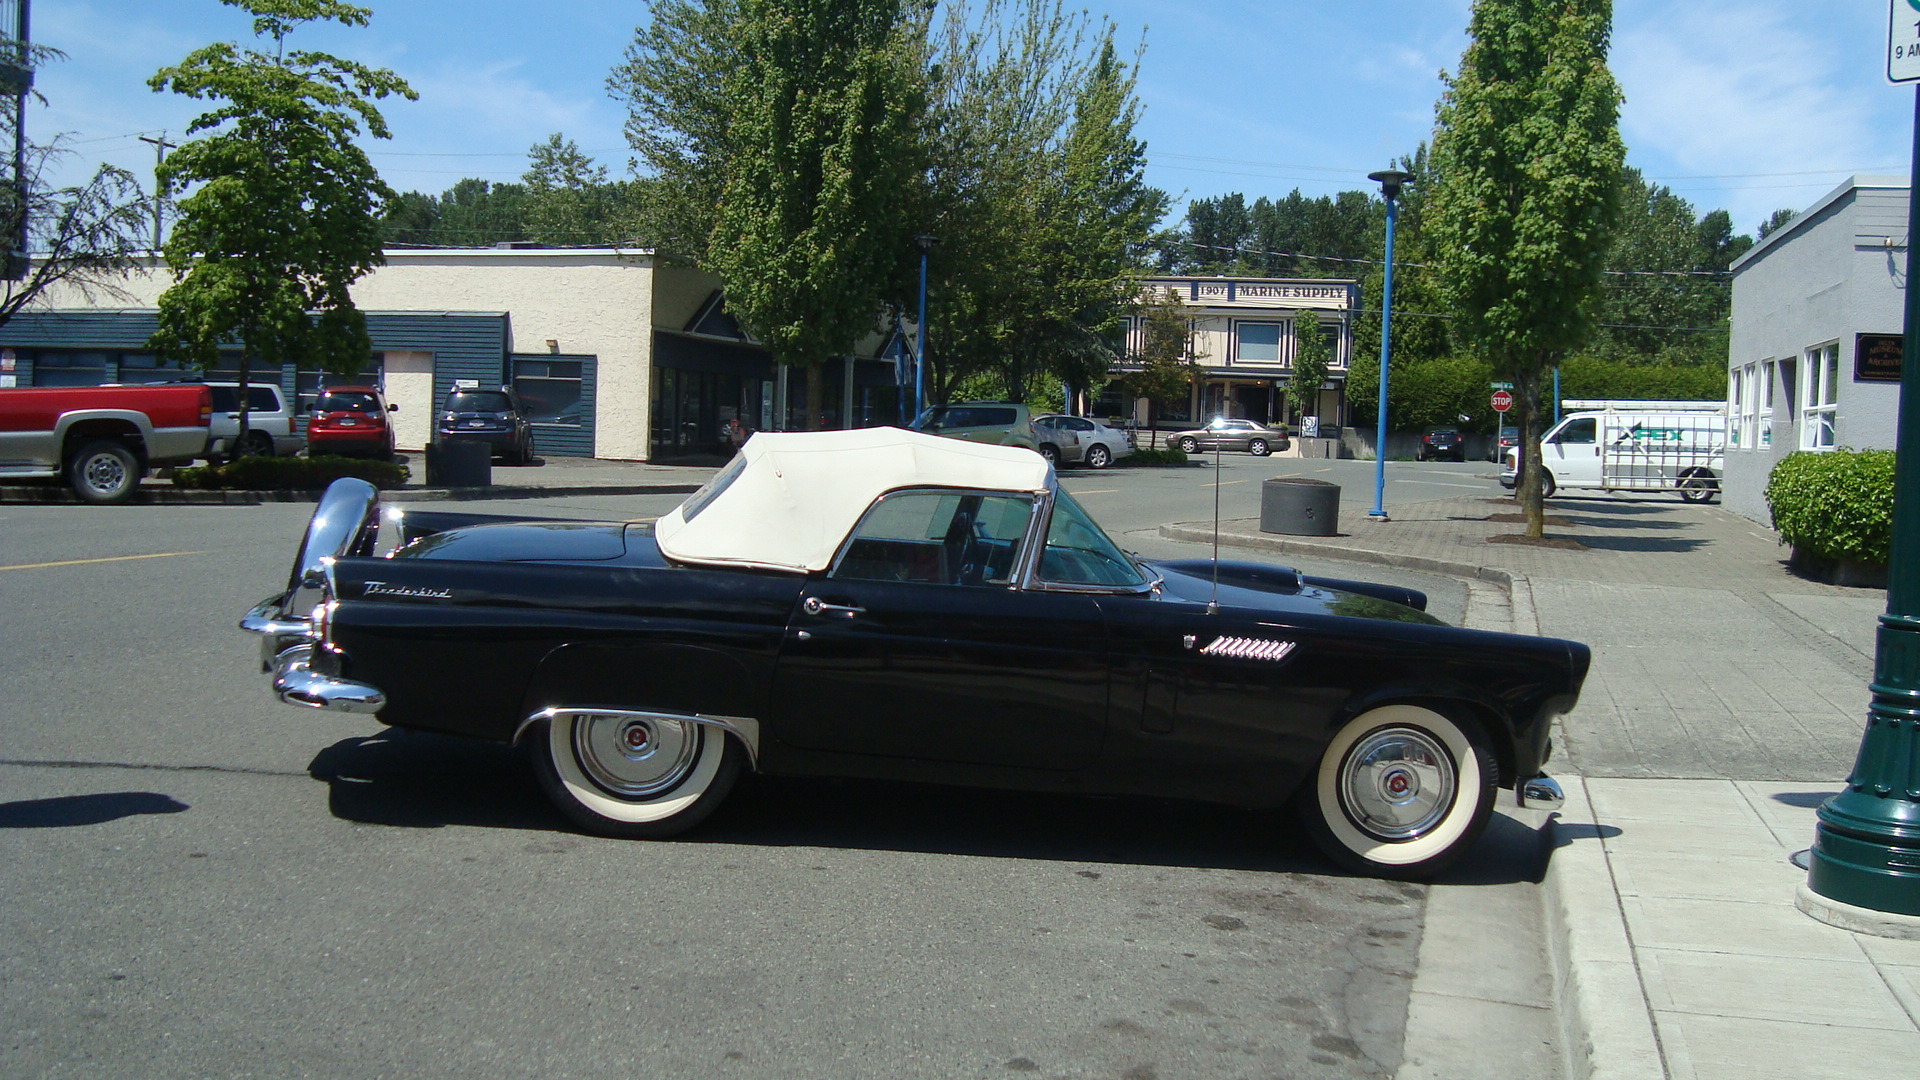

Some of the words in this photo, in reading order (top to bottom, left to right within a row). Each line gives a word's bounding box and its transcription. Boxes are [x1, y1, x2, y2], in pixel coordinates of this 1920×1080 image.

[1895, 45, 1903, 59] 9
[1200, 286, 1226, 296] 1907
[1240, 285, 1290, 297] MARINE
[1293, 286, 1344, 299] SUPPLY
[1869, 345, 1903, 355] MUSEUM
[1492, 397, 1511, 406] STOP
[363, 580, 453, 599] Thunderbird
